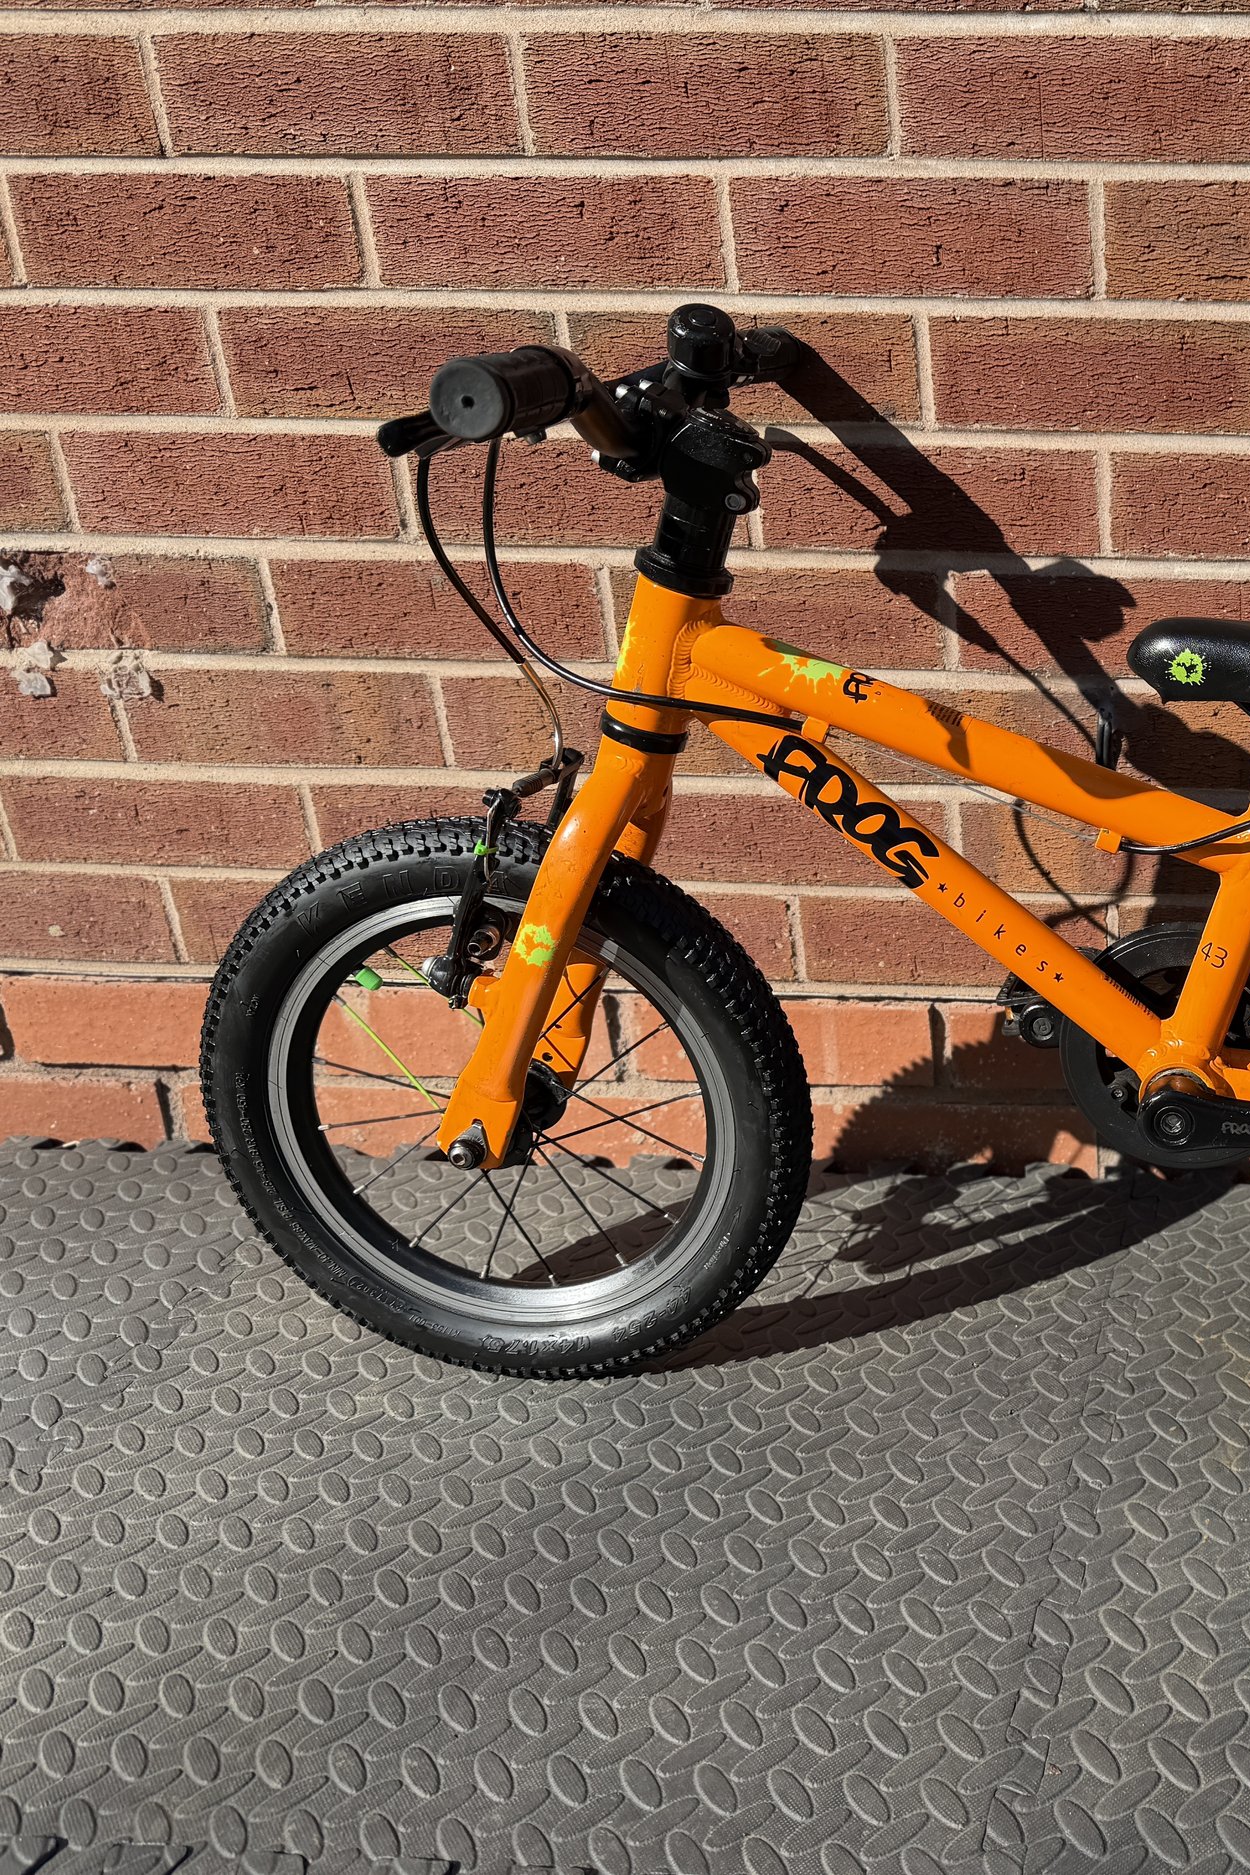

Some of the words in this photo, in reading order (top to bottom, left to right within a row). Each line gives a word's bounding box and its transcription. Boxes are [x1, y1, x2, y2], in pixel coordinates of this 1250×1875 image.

[756, 734, 940, 889] FROG
[296, 865, 522, 937] KENDA
[954, 892, 1049, 973] bikes
[1200, 942, 1228, 969] 43
[612, 1283, 692, 1343] 44-254
